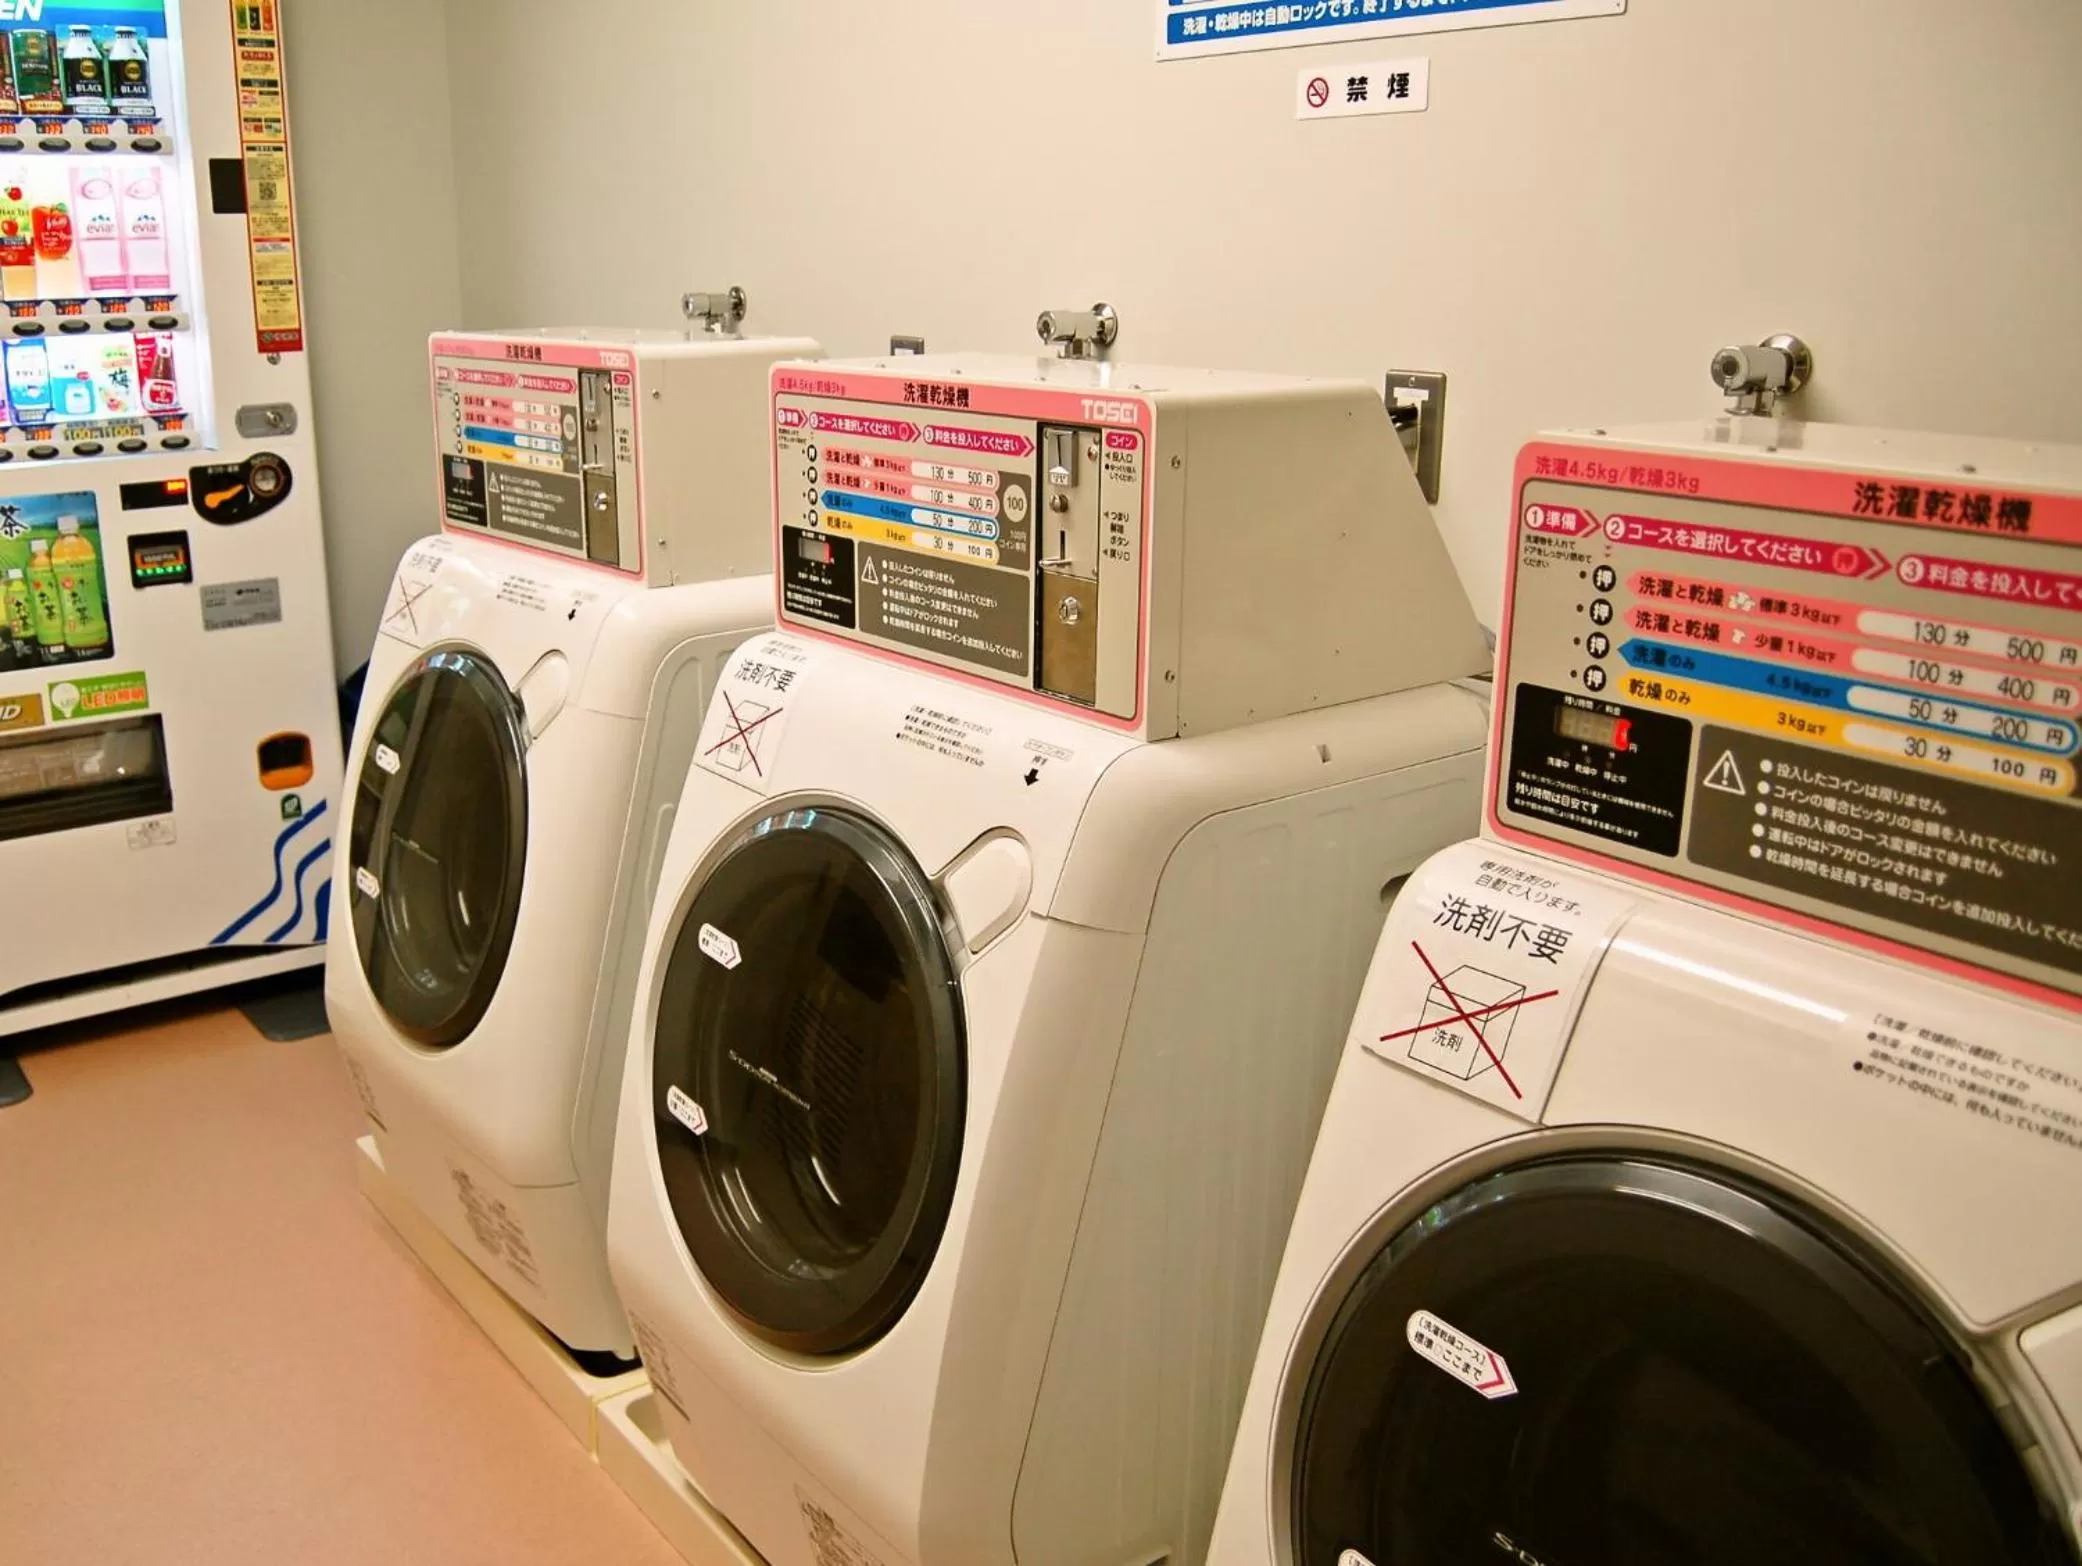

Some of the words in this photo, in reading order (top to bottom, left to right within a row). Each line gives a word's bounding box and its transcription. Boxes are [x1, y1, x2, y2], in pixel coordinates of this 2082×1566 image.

[75, 83, 103, 93] BLACK
[1346, 72, 1410, 102] 禁煙
[903, 382, 970, 408] 洗濯乾燥機
[1080, 399, 1139, 425] TOSEI
[1111, 435, 1133, 449] コイン
[0, 505, 29, 537] 茶
[1007, 496, 1024, 512] 100
[1851, 481, 2033, 532] 洗濯乾燥機
[1595, 567, 1615, 591] 押
[1639, 576, 1725, 608] 洗濯と乾燥
[1913, 621, 1947, 645] 130
[1953, 630, 1971, 647] 分
[2006, 637, 2045, 663] 500
[2059, 647, 2078, 666] 円
[1592, 600, 1611, 623] 押
[1635, 610, 1720, 643] 洗濯と乾燥
[1909, 659, 1941, 684] 100
[1947, 669, 1964, 686] 分
[1997, 676, 2035, 702] 400
[2052, 687, 2071, 706] 円
[1588, 634, 1608, 657] 押
[1909, 699, 1932, 721] 50
[1943, 708, 1958, 725] 分
[1990, 716, 2029, 741] 200
[2046, 727, 2064, 746] 円
[1585, 667, 1604, 690] 押
[1628, 678, 1691, 705] 乾燥のみ
[1903, 736, 1928, 759] 30
[1935, 745, 1952, 762] 分
[1991, 758, 2025, 778] 100
[2039, 767, 2057, 786] 円
[1515, 781, 1600, 815] 残り時間は目安です
[1773, 785, 2059, 865] コインの場合ピッタリの金額を入れてください
[1480, 860, 1560, 889] 専用洗剤が
[1768, 827, 1948, 887] 運転中はドアがロックされます
[1432, 893, 1574, 965] 洗剤不要
[1432, 1027, 1464, 1053] 洗剤
